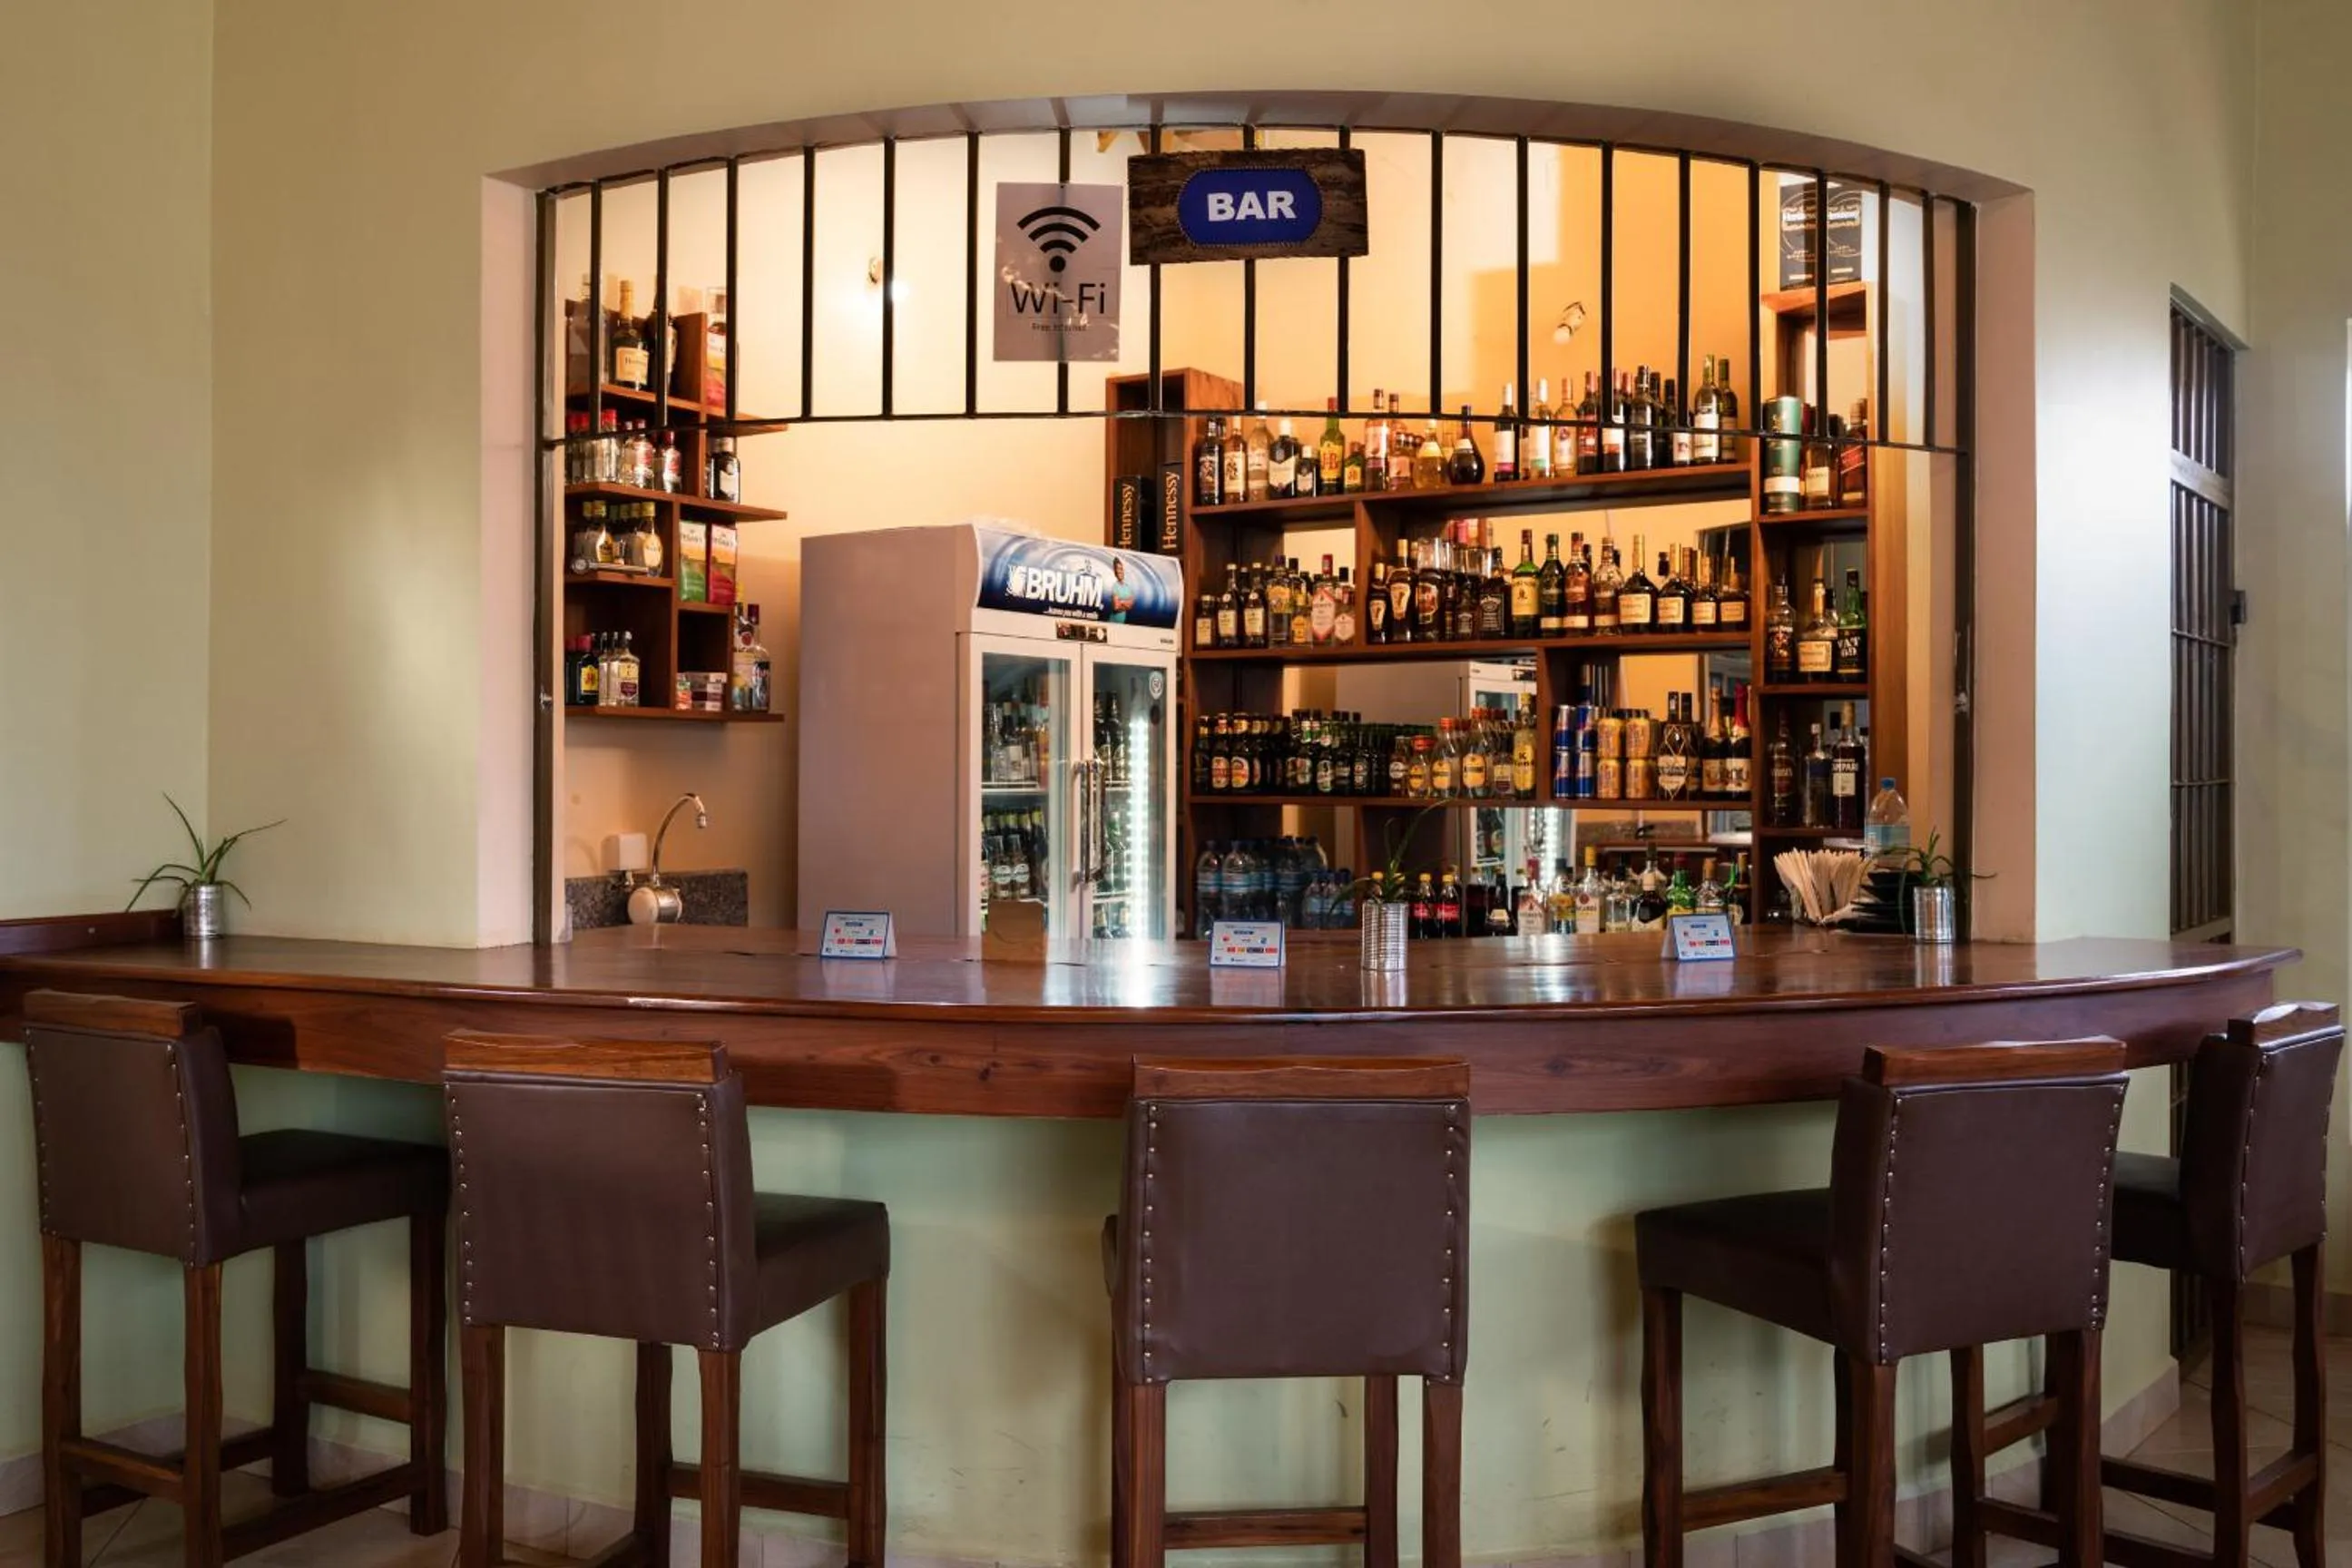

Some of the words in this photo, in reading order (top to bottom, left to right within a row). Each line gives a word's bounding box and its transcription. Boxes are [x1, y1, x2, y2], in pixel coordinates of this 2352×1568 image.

[1207, 191, 1298, 222] BAR
[1011, 281, 1106, 314] Wi-Fi
[1161, 472, 1180, 550] Hennessy
[1837, 636, 1861, 649] VAT
